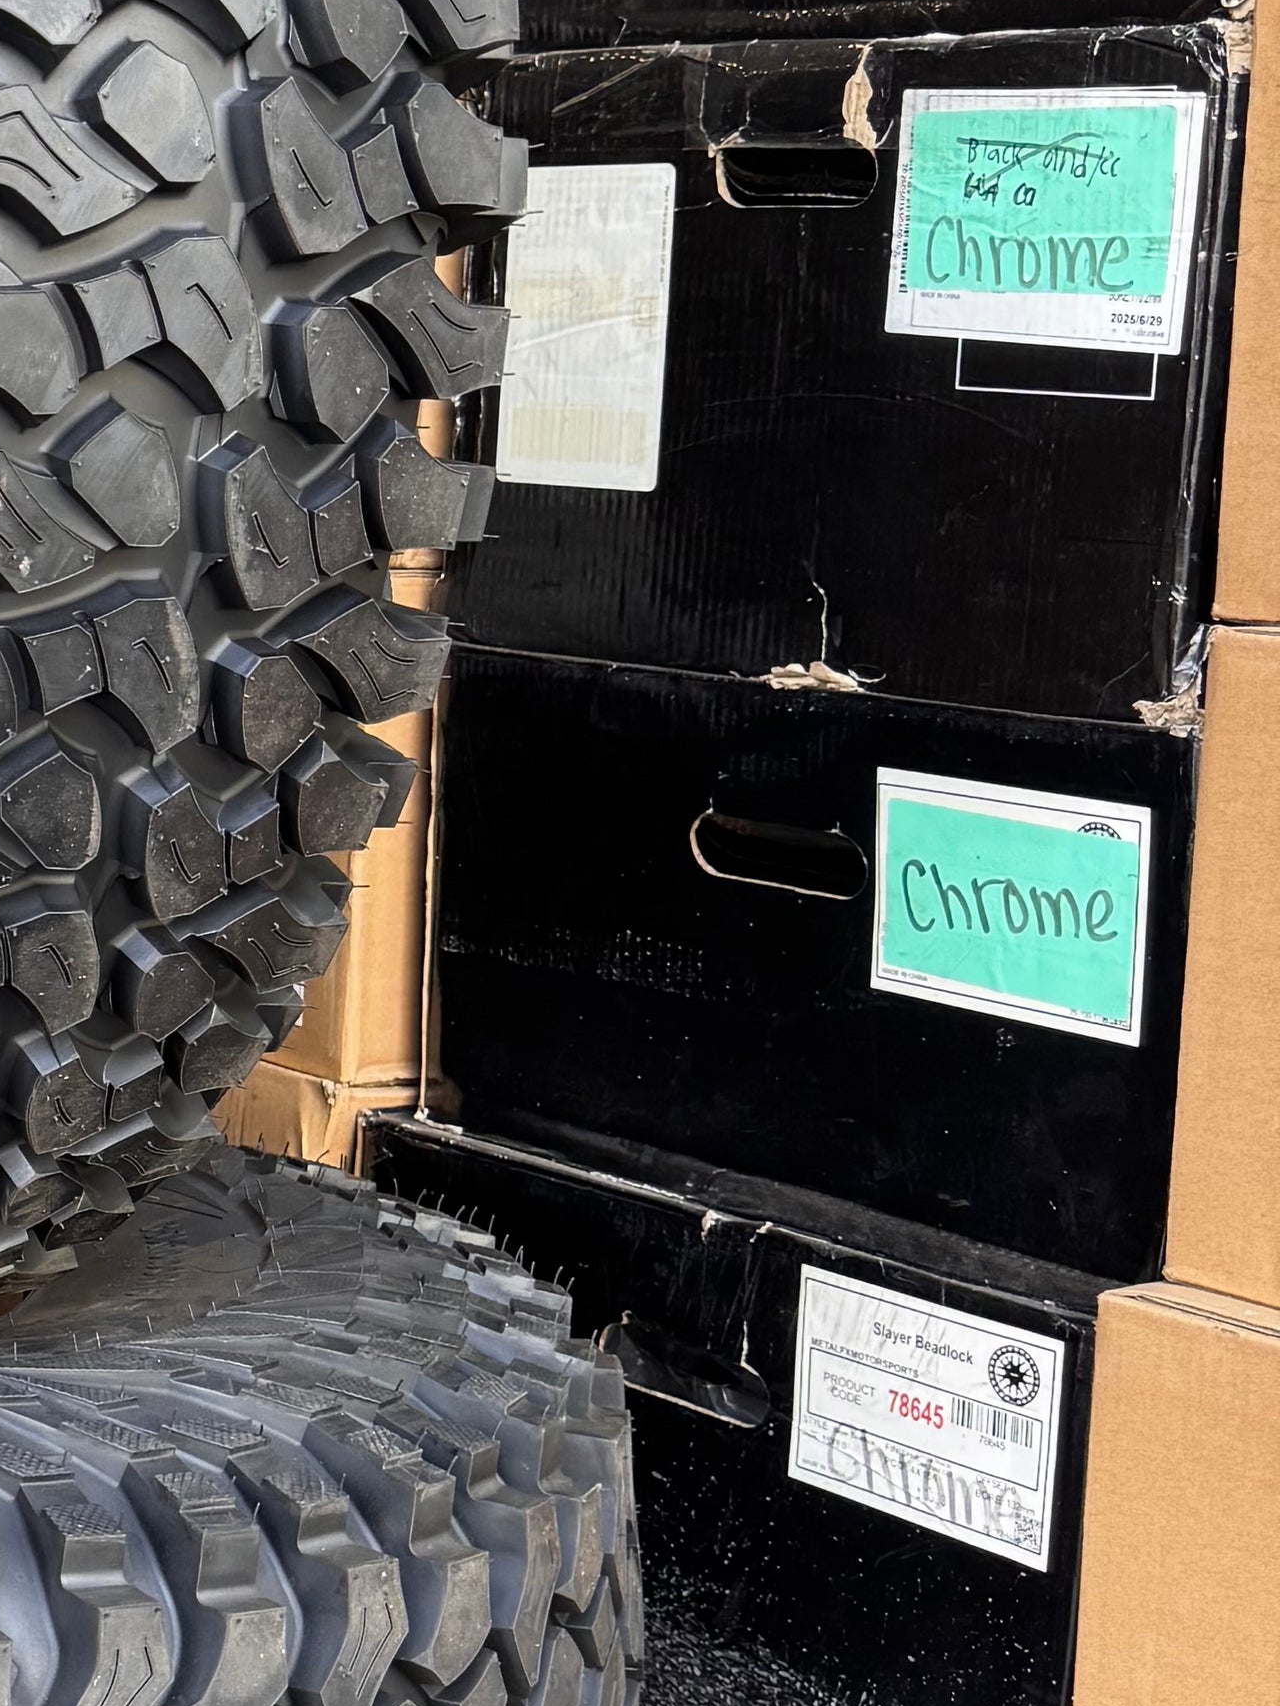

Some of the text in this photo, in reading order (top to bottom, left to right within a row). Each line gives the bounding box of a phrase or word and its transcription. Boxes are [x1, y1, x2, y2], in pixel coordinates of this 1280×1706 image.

[926, 215, 1134, 293] Chrome
[1111, 312, 1163, 327] 2025/6/29
[902, 858, 1119, 943] Chrome
[811, 1336, 920, 1379] METALFXMOTORSPORTS
[873, 1321, 974, 1366] Slayer Beadlock
[823, 1371, 877, 1398] PRODUCT
[830, 1386, 862, 1407] CODE
[888, 1388, 945, 1430] 78645
[978, 1434, 1007, 1453] 78645
